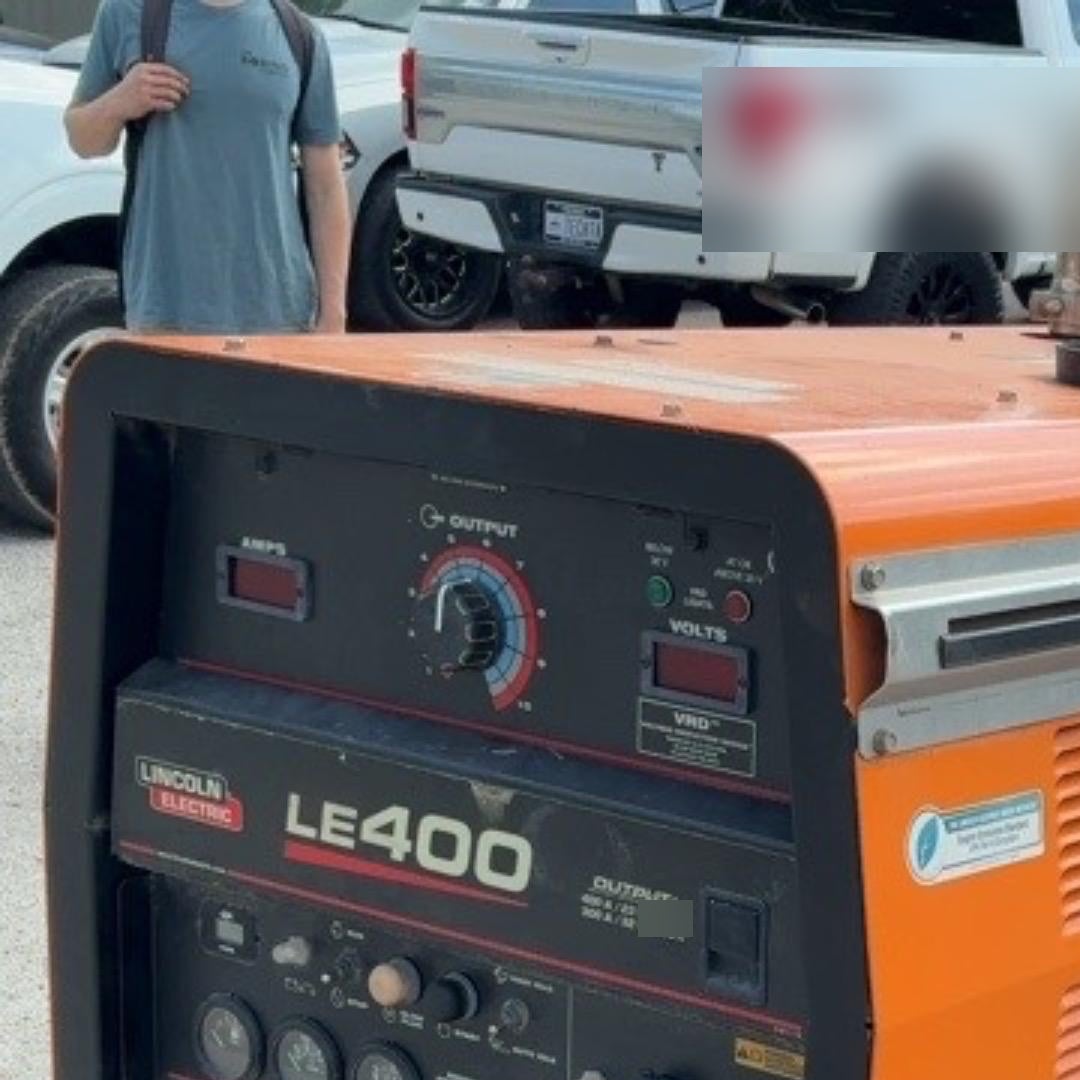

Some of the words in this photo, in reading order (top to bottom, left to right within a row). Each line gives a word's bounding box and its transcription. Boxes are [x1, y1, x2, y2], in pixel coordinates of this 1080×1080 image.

[448, 513, 519, 539] OUTPUT
[669, 617, 728, 643] VOLTS
[139, 760, 224, 801] LINCOLN
[160, 790, 233, 824] ELECTRIC
[284, 792, 533, 893] LE400
